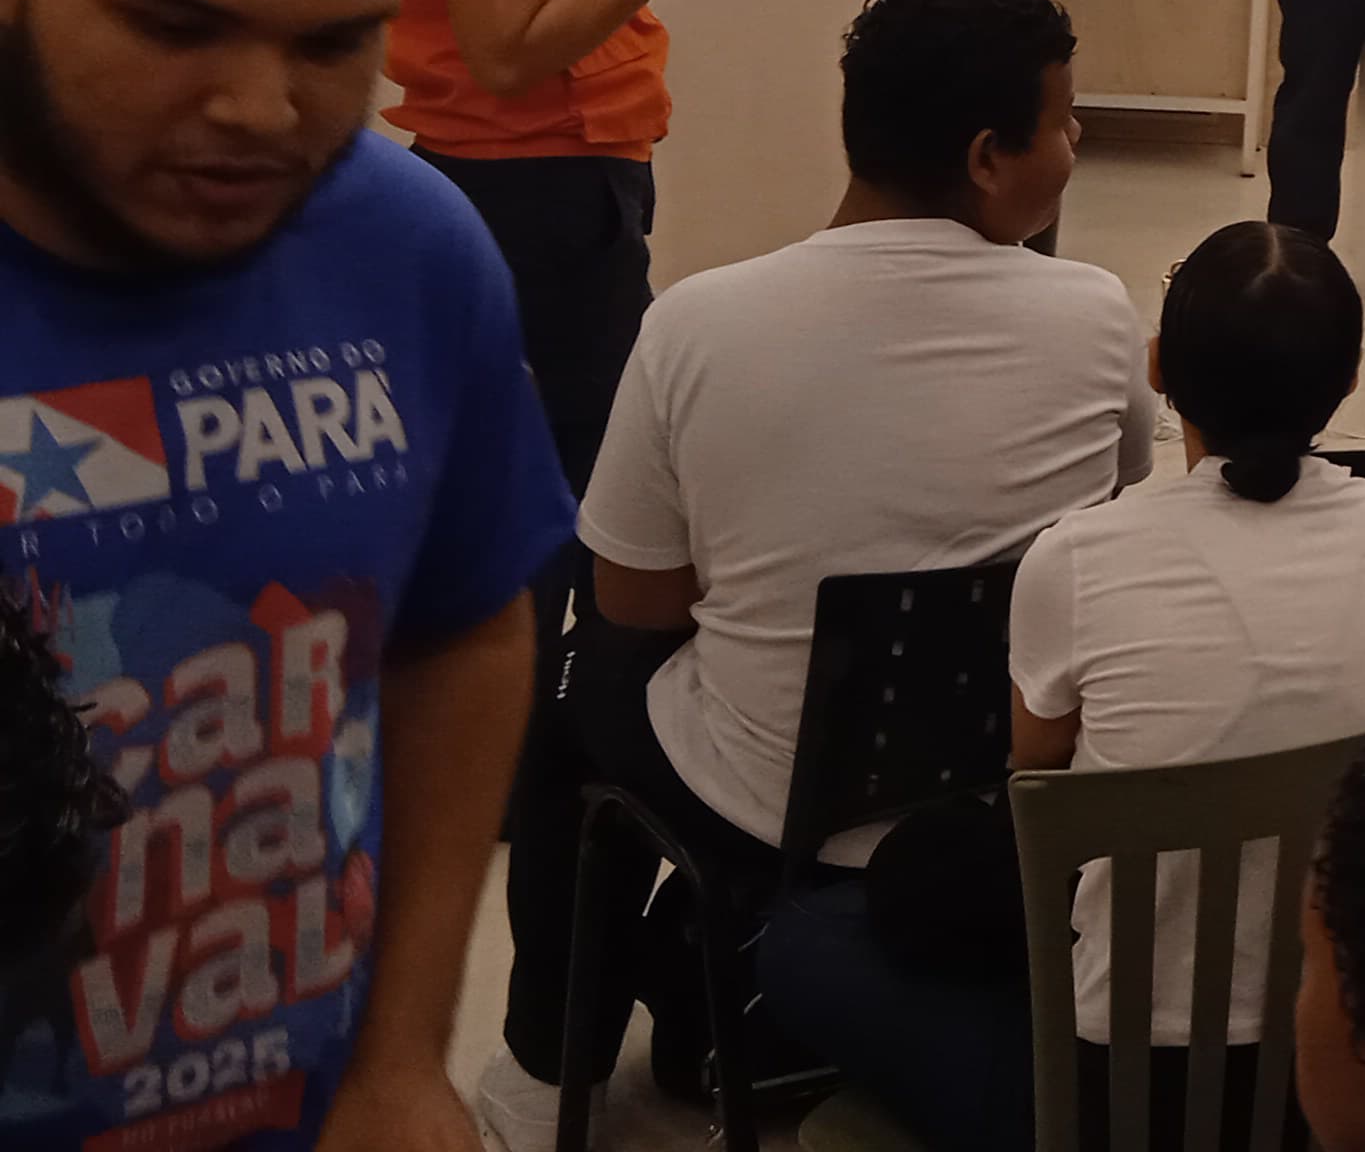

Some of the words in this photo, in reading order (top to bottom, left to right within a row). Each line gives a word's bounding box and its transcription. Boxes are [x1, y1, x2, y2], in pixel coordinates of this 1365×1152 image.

[169, 346, 331, 395] GOVERNO
[341, 338, 385, 368] DO
[176, 367, 408, 491] PARÁ
[259, 483, 283, 512] O
[124, 1024, 291, 1119] 2025
